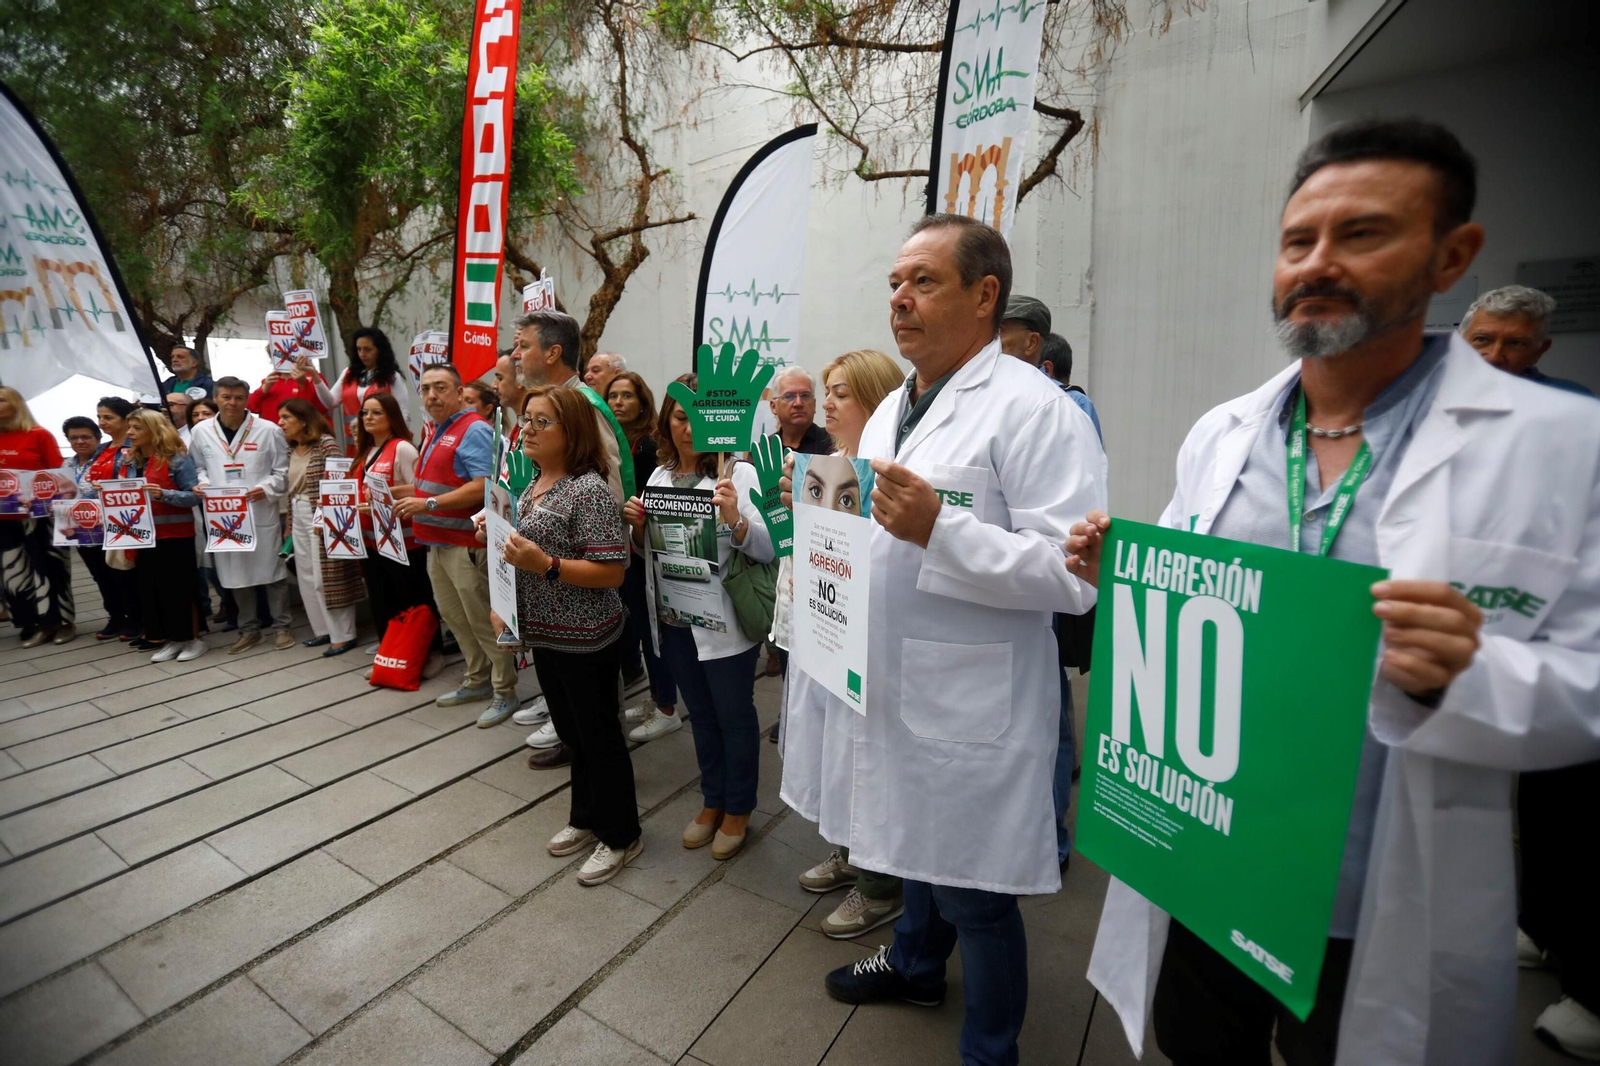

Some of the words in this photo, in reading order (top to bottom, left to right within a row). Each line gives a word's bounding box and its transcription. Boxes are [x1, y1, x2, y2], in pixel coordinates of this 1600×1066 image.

[953, 46, 1016, 105] SMA
[956, 96, 1017, 129] CÓRDOBA
[272, 322, 292, 334] STO
[709, 314, 782, 352] SMA
[429, 345, 446, 354] STOP
[713, 356, 786, 367] CROBA
[706, 390, 738, 398] #STOP
[692, 399, 751, 407] AGRESIONES
[1292, 430, 1302, 458] SATSE
[0, 480, 14, 488] OP
[34, 481, 53, 490] STOP
[105, 492, 140, 505] STOP
[207, 498, 242, 511] STOP
[328, 496, 350, 505] STOP
[763, 496, 781, 510] AGRESIO
[934, 488, 973, 508] TSE
[644, 499, 712, 513] RECOMENDADO
[1329, 493, 1350, 527] SATSE
[74, 511, 96, 519] STOP
[107, 524, 151, 540] AGRIONES
[209, 528, 252, 544] AGRIONES
[825, 539, 833, 551] LA
[661, 562, 702, 576] RESPETO
[809, 552, 852, 579] AGRESIÓN
[1113, 539, 1138, 582] LA
[1141, 546, 1263, 614] AGRESIÓN
[819, 580, 836, 604] NO
[810, 598, 816, 609] ES
[817, 602, 847, 626] SOLUCIÓN
[1110, 582, 1245, 784] NO
[1096, 732, 1122, 775] ES
[1124, 746, 1235, 837] SOLUCIÓN
[1230, 928, 1294, 986] SATSE
